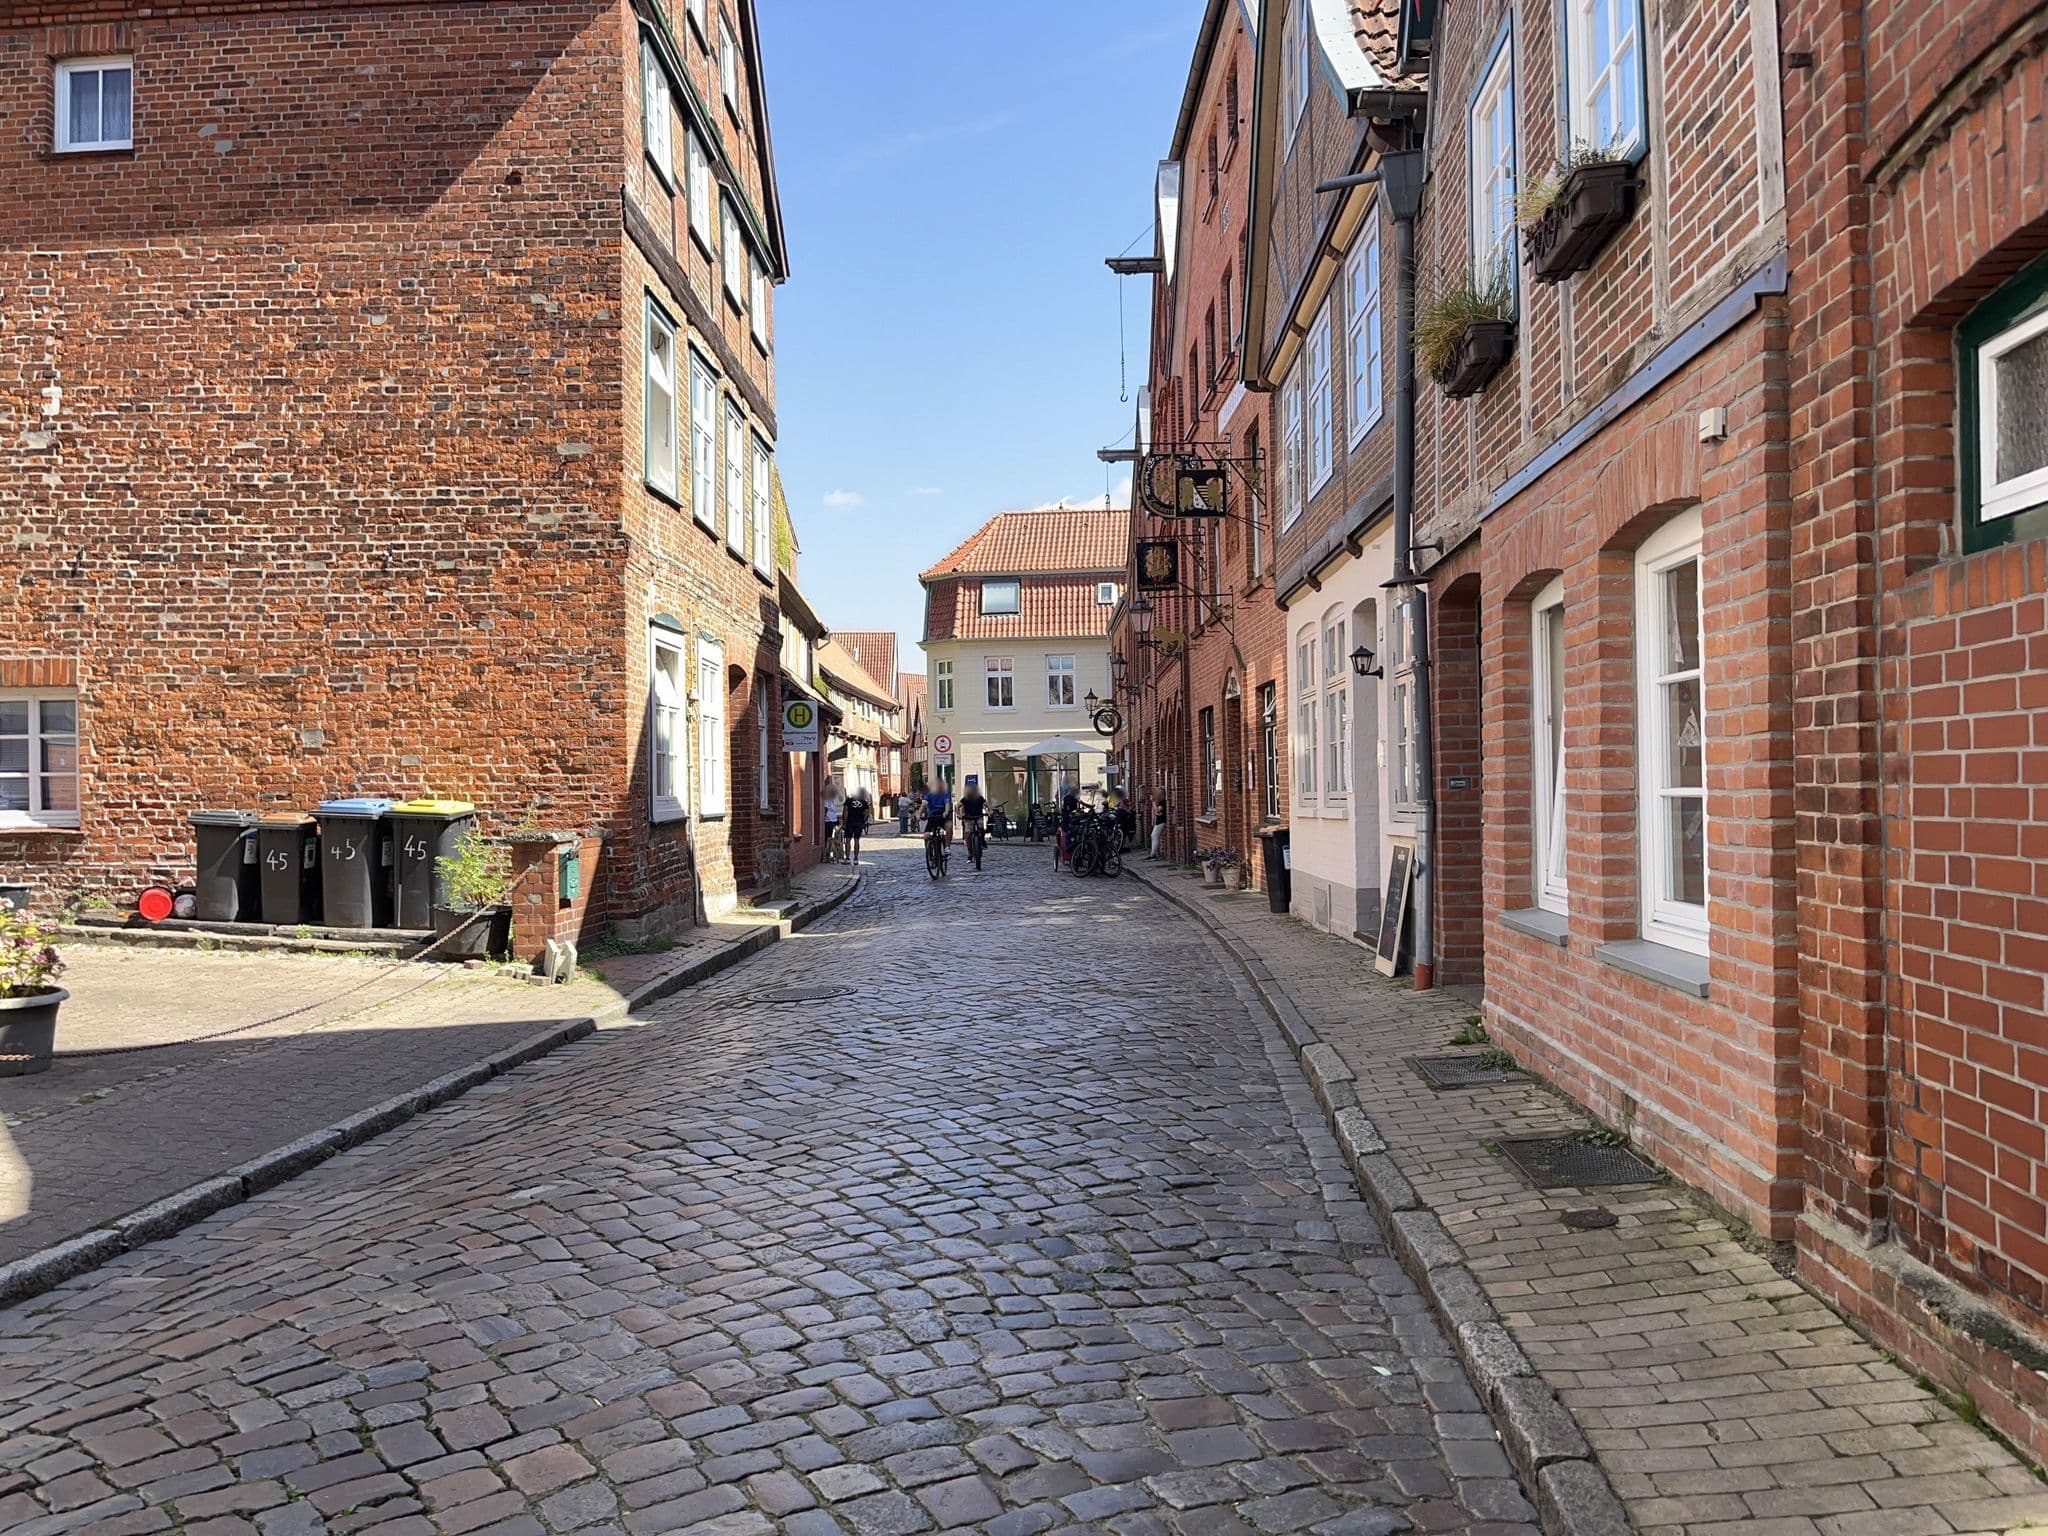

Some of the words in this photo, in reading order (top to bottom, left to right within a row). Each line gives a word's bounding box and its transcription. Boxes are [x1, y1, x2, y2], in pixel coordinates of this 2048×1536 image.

[794, 707, 806, 723] H
[330, 838, 356, 860] 45
[404, 834, 427, 860] 45
[265, 849, 288, 871] 45
